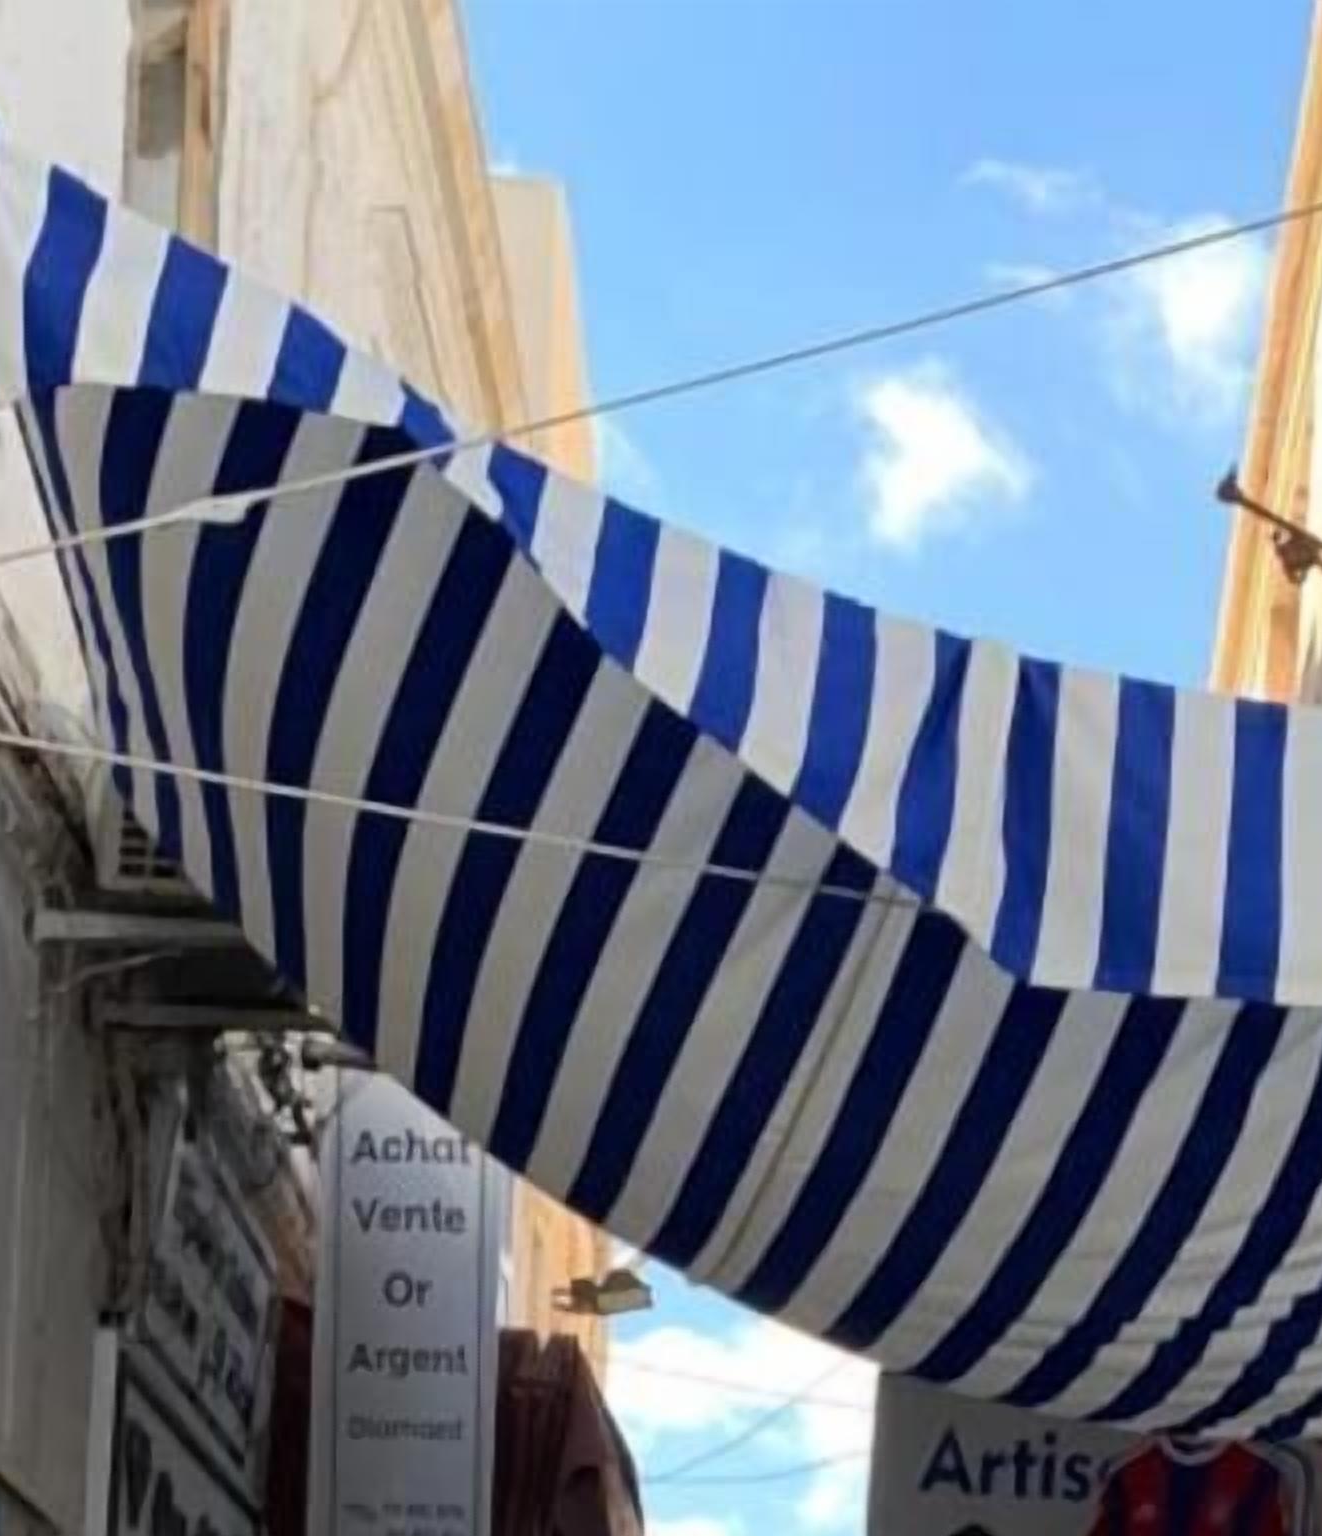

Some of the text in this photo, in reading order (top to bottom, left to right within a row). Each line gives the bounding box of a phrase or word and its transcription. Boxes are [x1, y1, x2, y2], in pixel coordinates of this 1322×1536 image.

[351, 1197, 467, 1236] Vente
[382, 1269, 434, 1309] Or
[346, 1343, 470, 1380] Argent
[917, 1426, 1111, 1504] Artis
